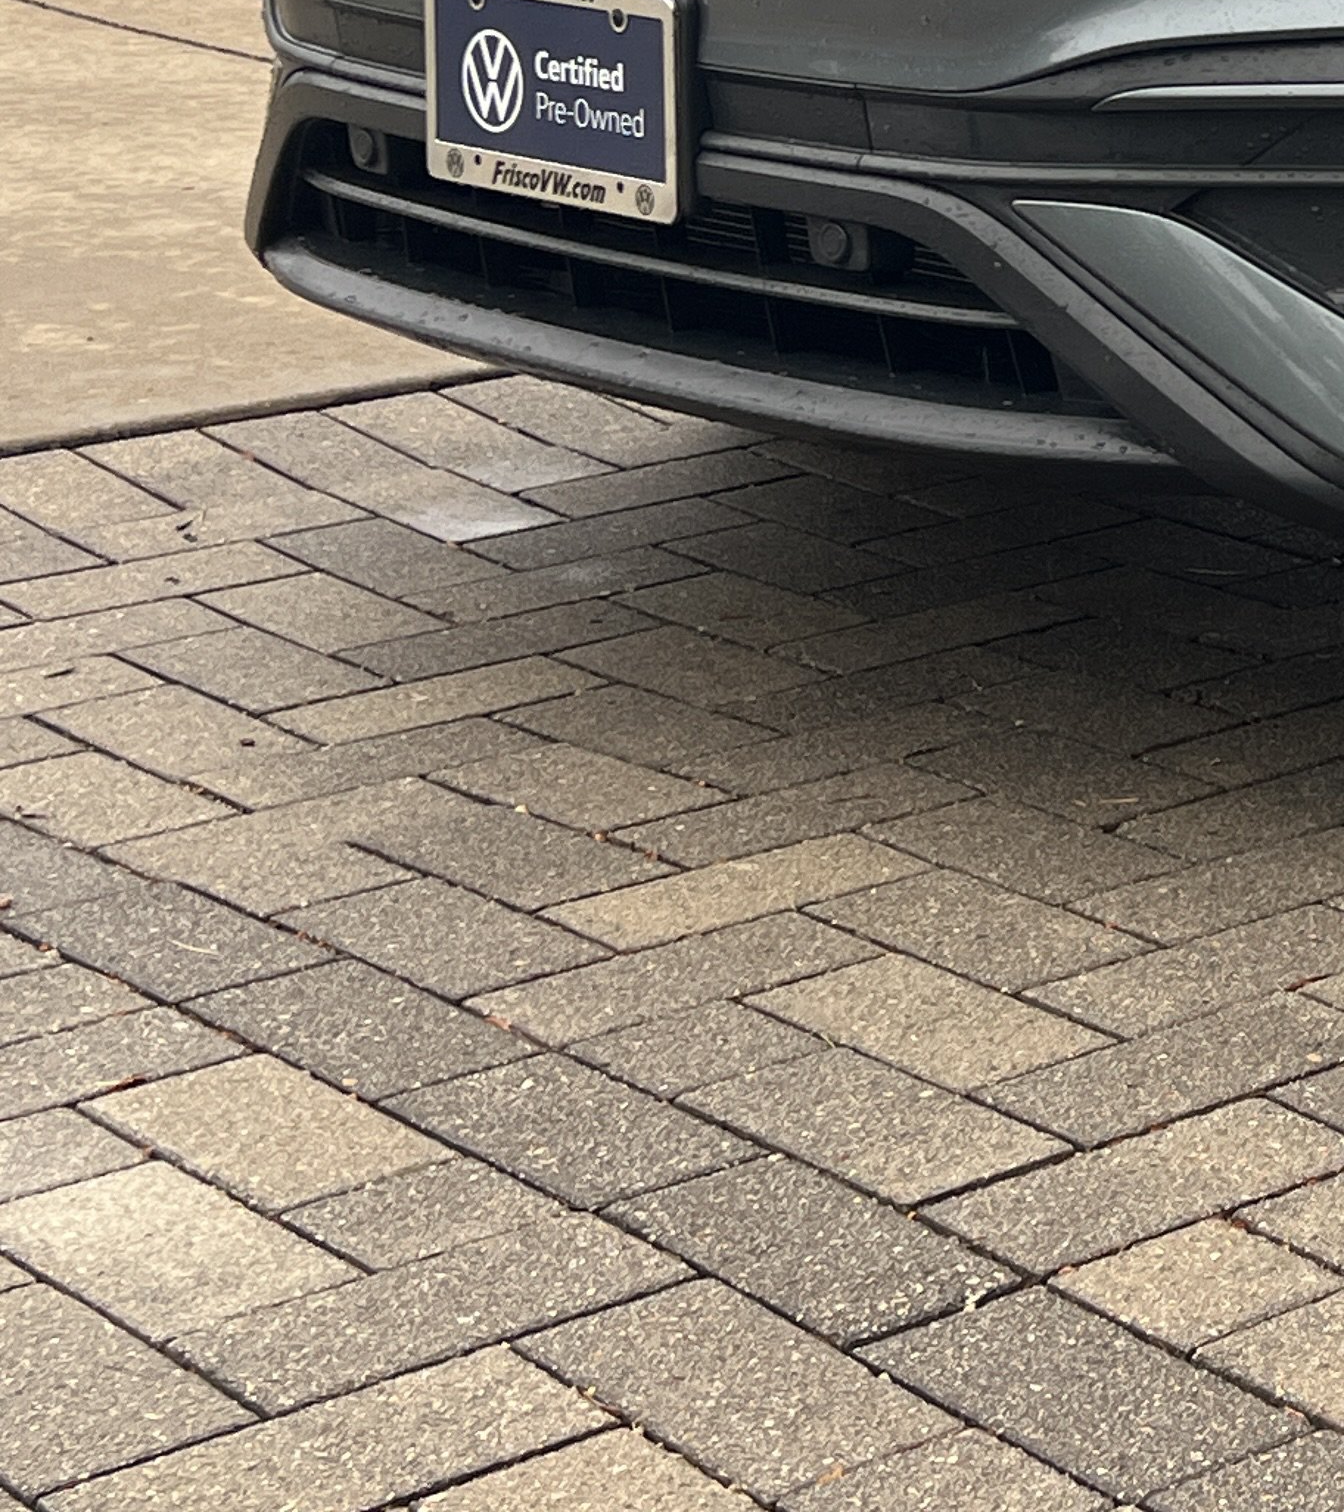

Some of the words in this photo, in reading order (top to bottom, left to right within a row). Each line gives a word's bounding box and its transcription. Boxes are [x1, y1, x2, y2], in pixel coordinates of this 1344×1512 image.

[534, 50, 624, 92] Certified
[535, 91, 646, 139] Pre-Owned
[491, 160, 607, 205] FriscoVW.com
